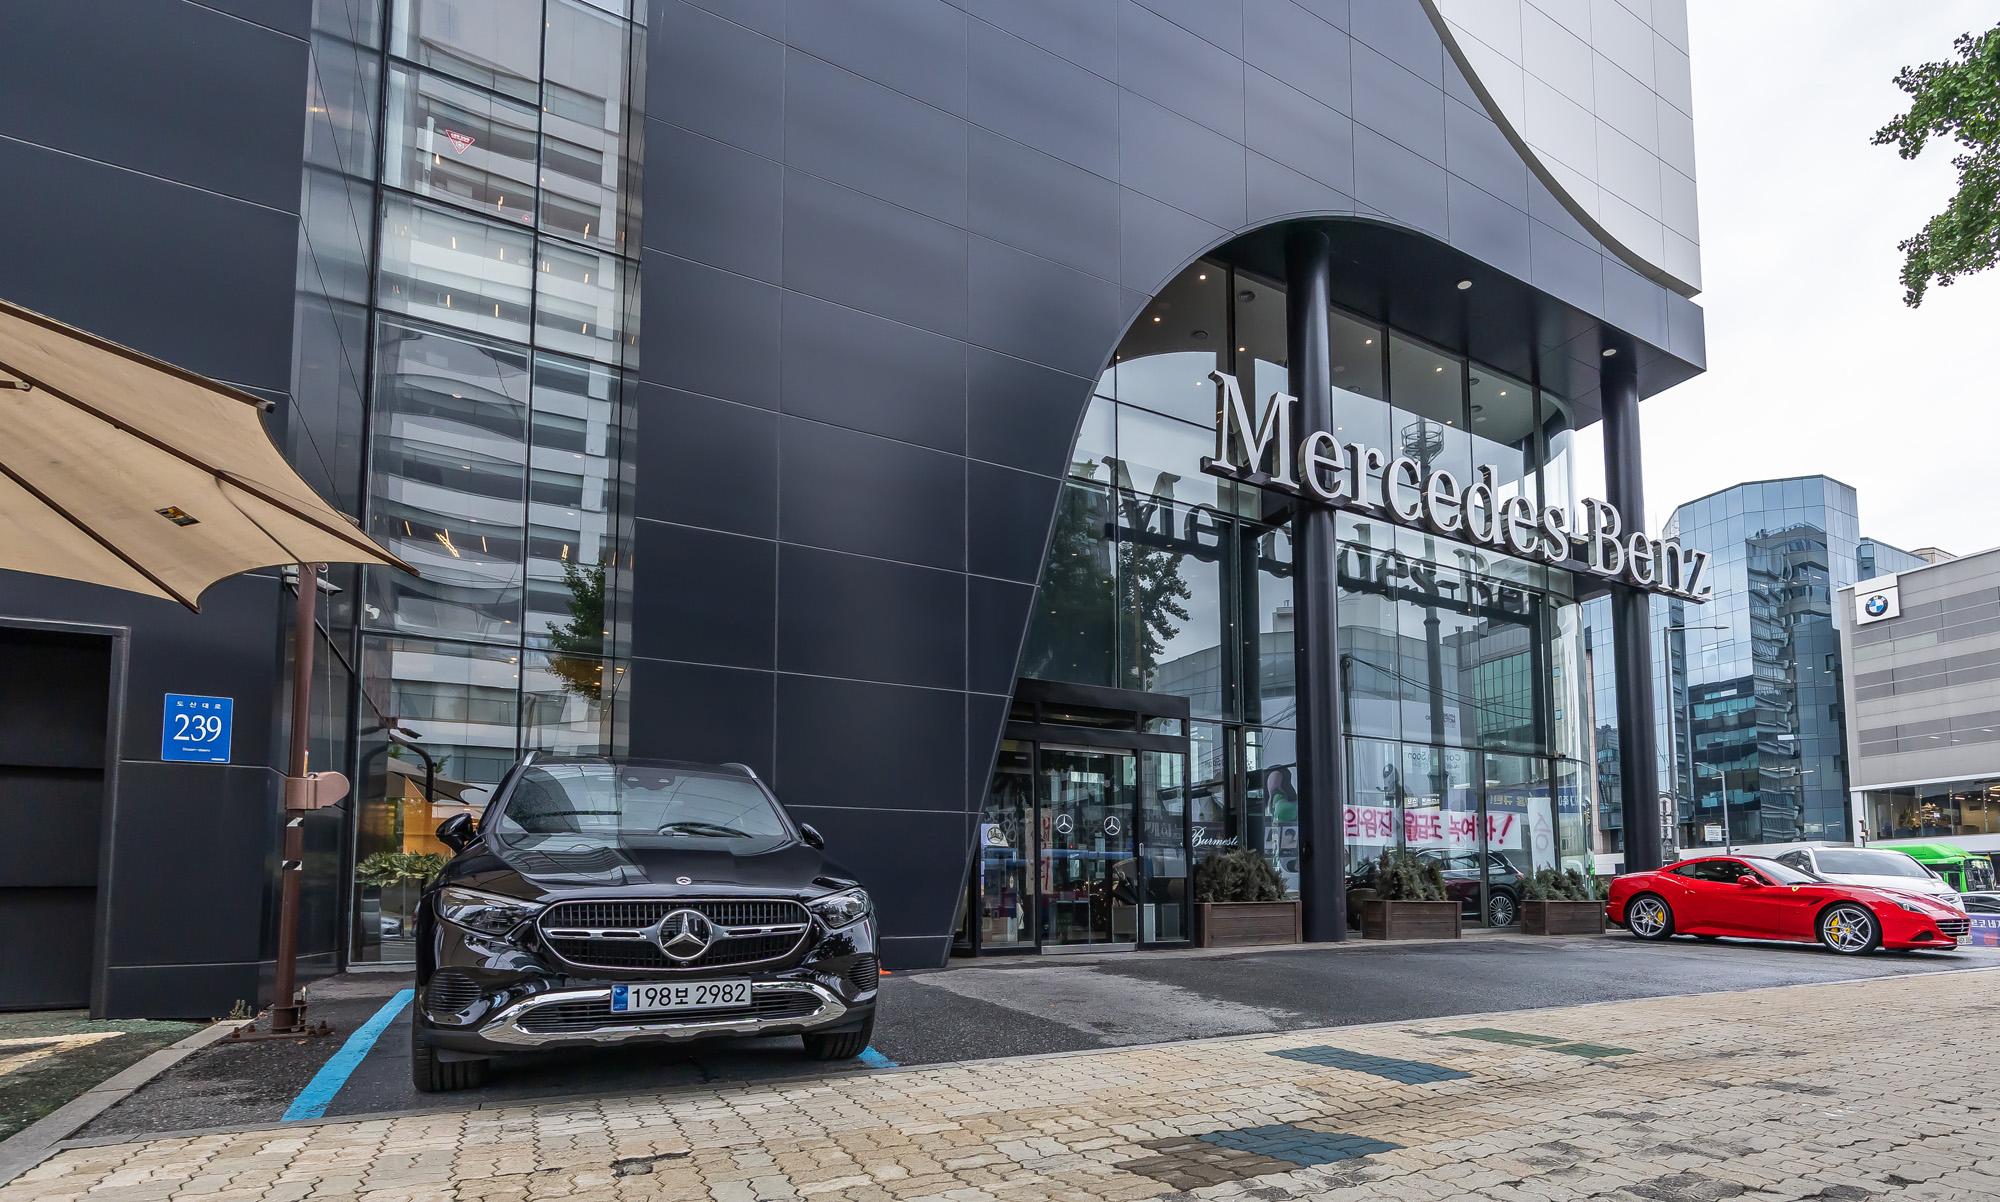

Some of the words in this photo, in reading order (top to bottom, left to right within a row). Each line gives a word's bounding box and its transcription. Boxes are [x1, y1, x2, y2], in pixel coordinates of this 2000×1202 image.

[1203, 370, 1711, 604] Mercedes-Benz
[173, 713, 222, 742] 239
[1343, 808, 1393, 838] 임원진
[632, 987, 689, 1008] 198보
[695, 983, 746, 1005] 2982
